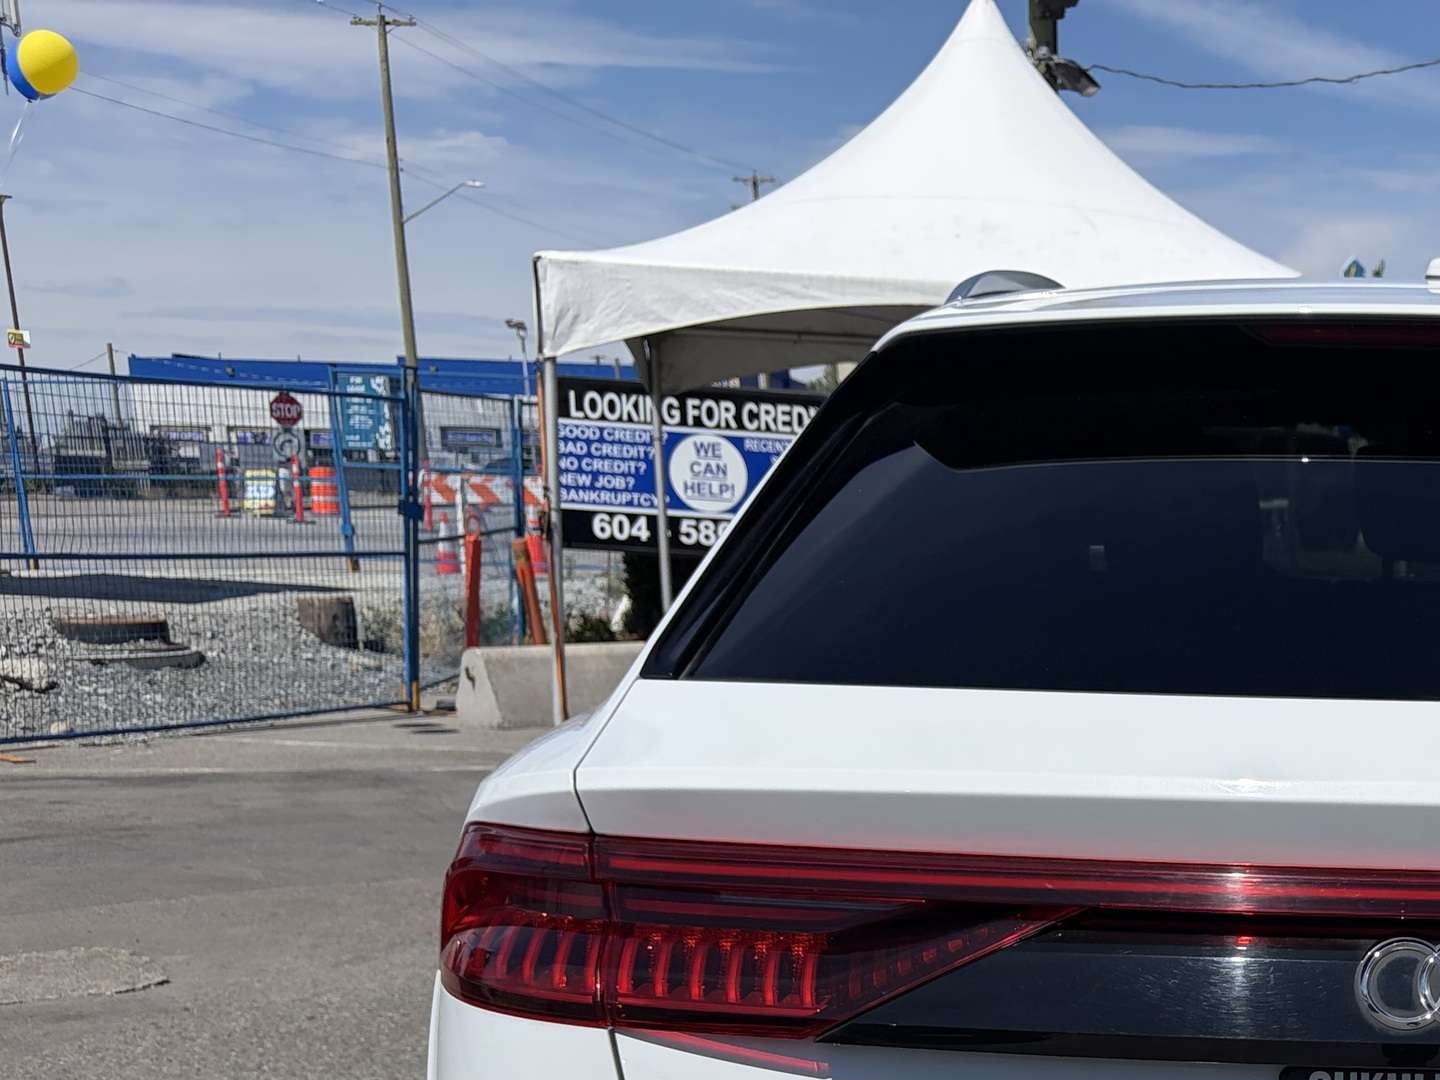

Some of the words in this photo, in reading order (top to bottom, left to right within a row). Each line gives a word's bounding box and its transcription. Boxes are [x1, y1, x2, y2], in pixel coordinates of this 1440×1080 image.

[272, 402, 300, 418] STOP
[686, 397, 738, 429] FOR
[694, 441, 722, 458] WE
[581, 459, 647, 475] CREDIT?
[690, 461, 728, 477] CAN
[595, 474, 636, 490] JOB?
[684, 481, 736, 497] HELP!
[592, 513, 651, 542] 604
